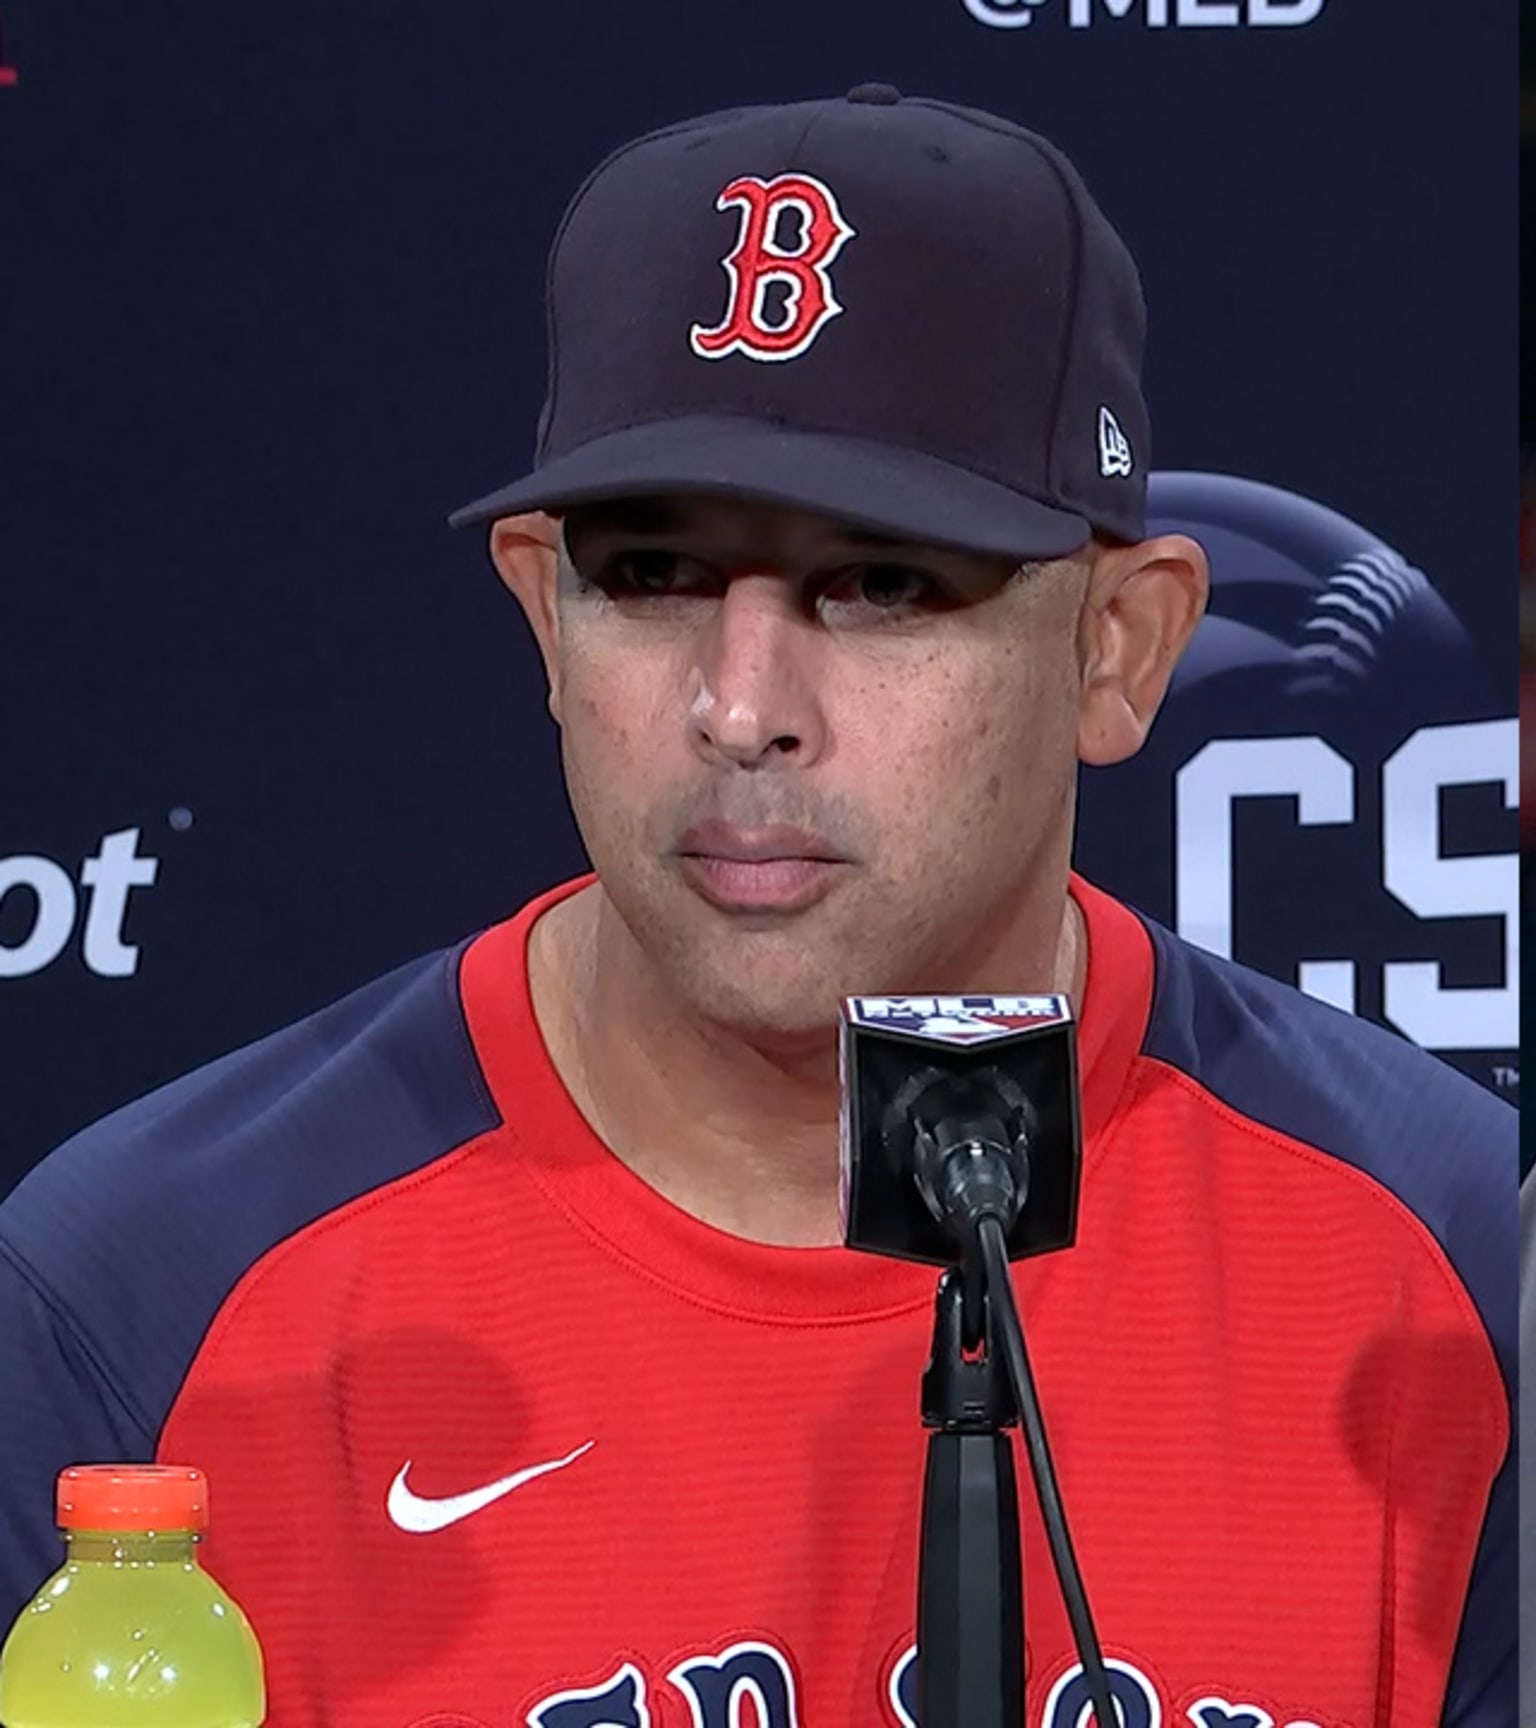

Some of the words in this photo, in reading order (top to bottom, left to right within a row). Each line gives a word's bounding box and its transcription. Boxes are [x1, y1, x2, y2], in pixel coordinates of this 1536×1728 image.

[690, 173, 857, 361] B
[0, 827, 159, 978] ot
[1176, 717, 1519, 1050] CS
